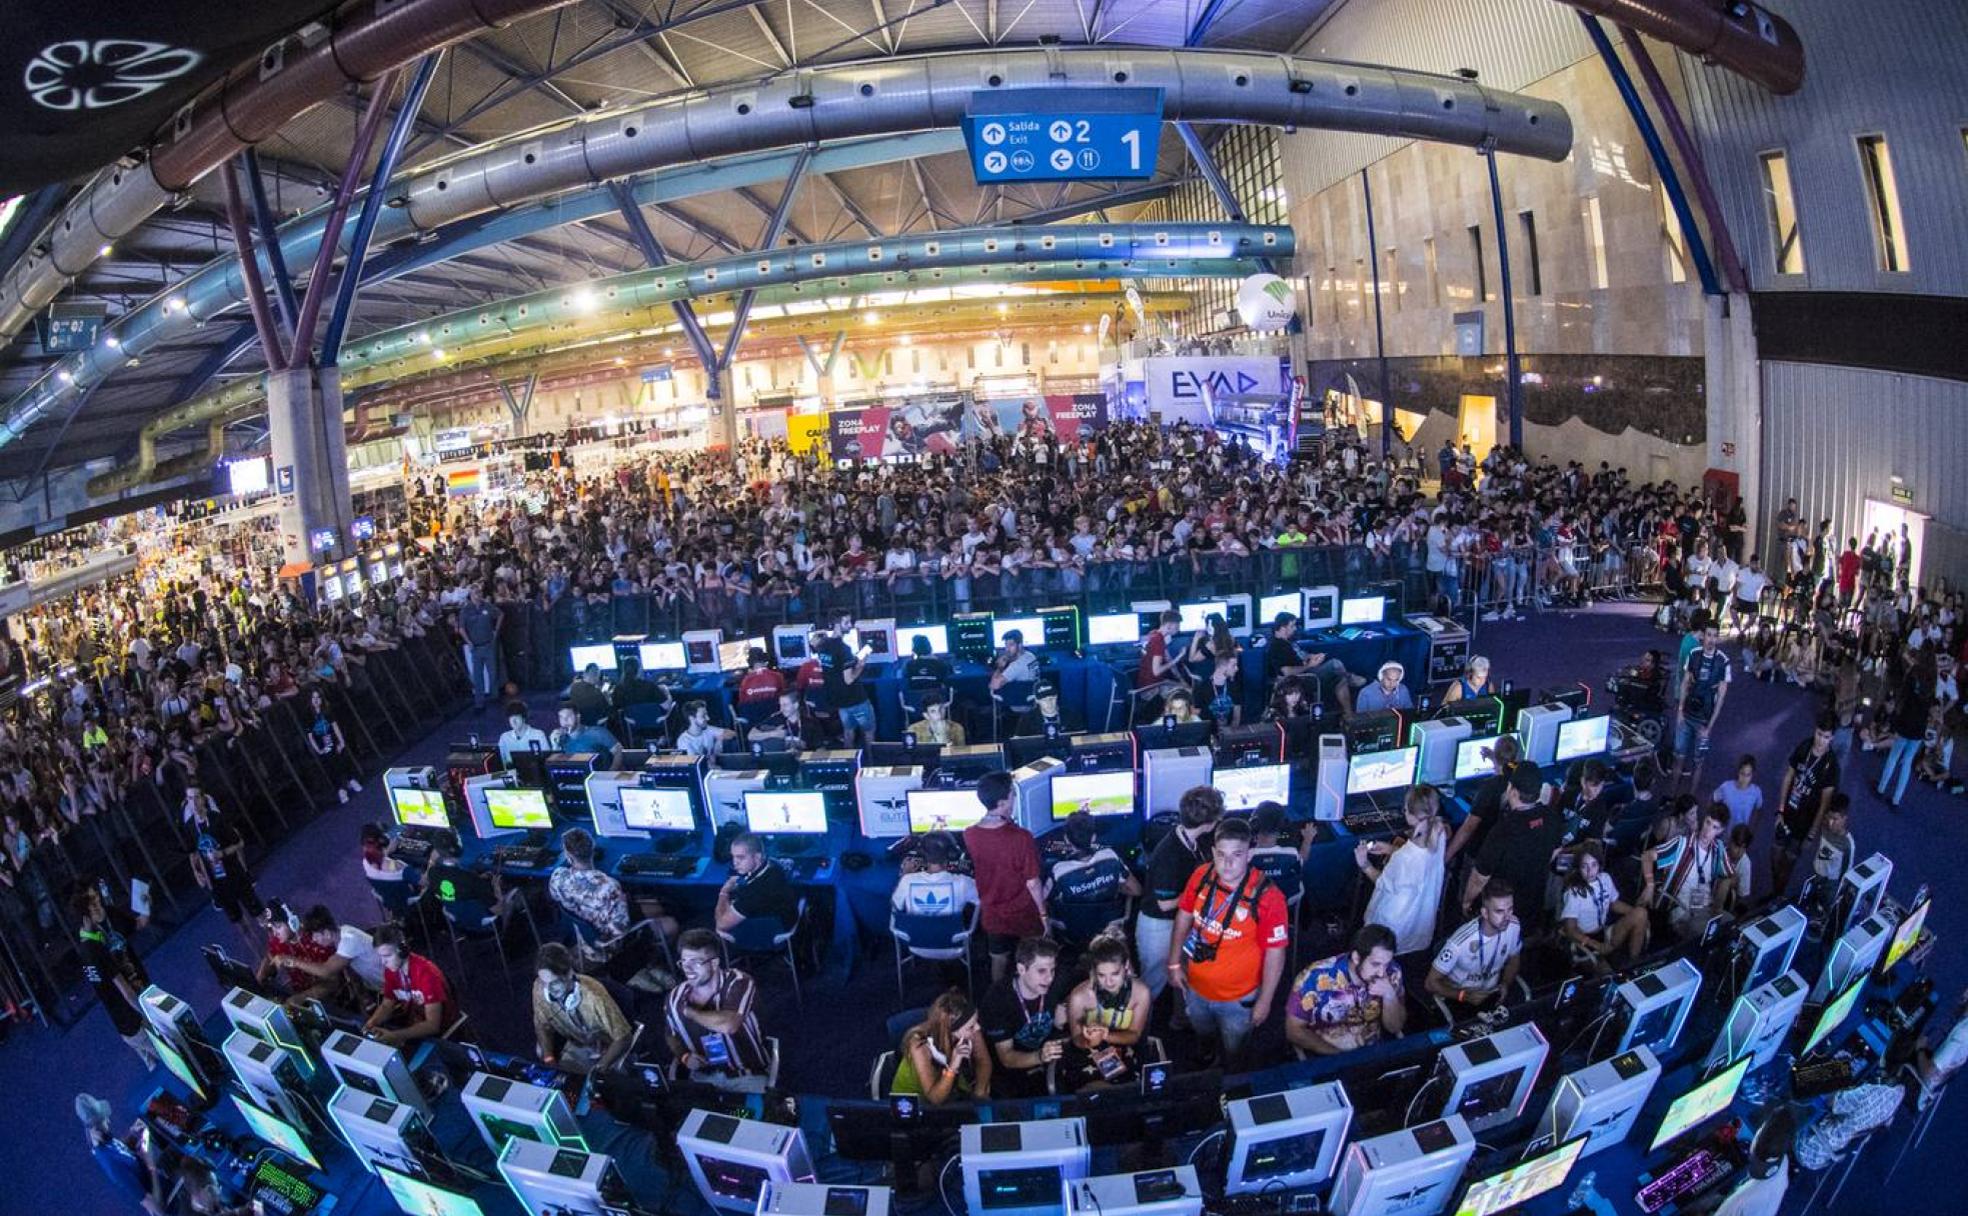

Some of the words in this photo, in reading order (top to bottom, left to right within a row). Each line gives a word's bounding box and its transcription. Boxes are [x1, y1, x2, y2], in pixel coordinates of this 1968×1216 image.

[1009, 121, 1040, 132] Salida
[1075, 120, 1091, 143] 2
[1010, 134, 1029, 145] Exit
[1121, 130, 1140, 170] 1
[90, 325, 97, 346] 1
[1072, 403, 1097, 412] ZONA
[1055, 410, 1097, 419] FREEPLAY
[838, 419, 864, 428] ZONA
[838, 424, 881, 436] FREEPLAY
